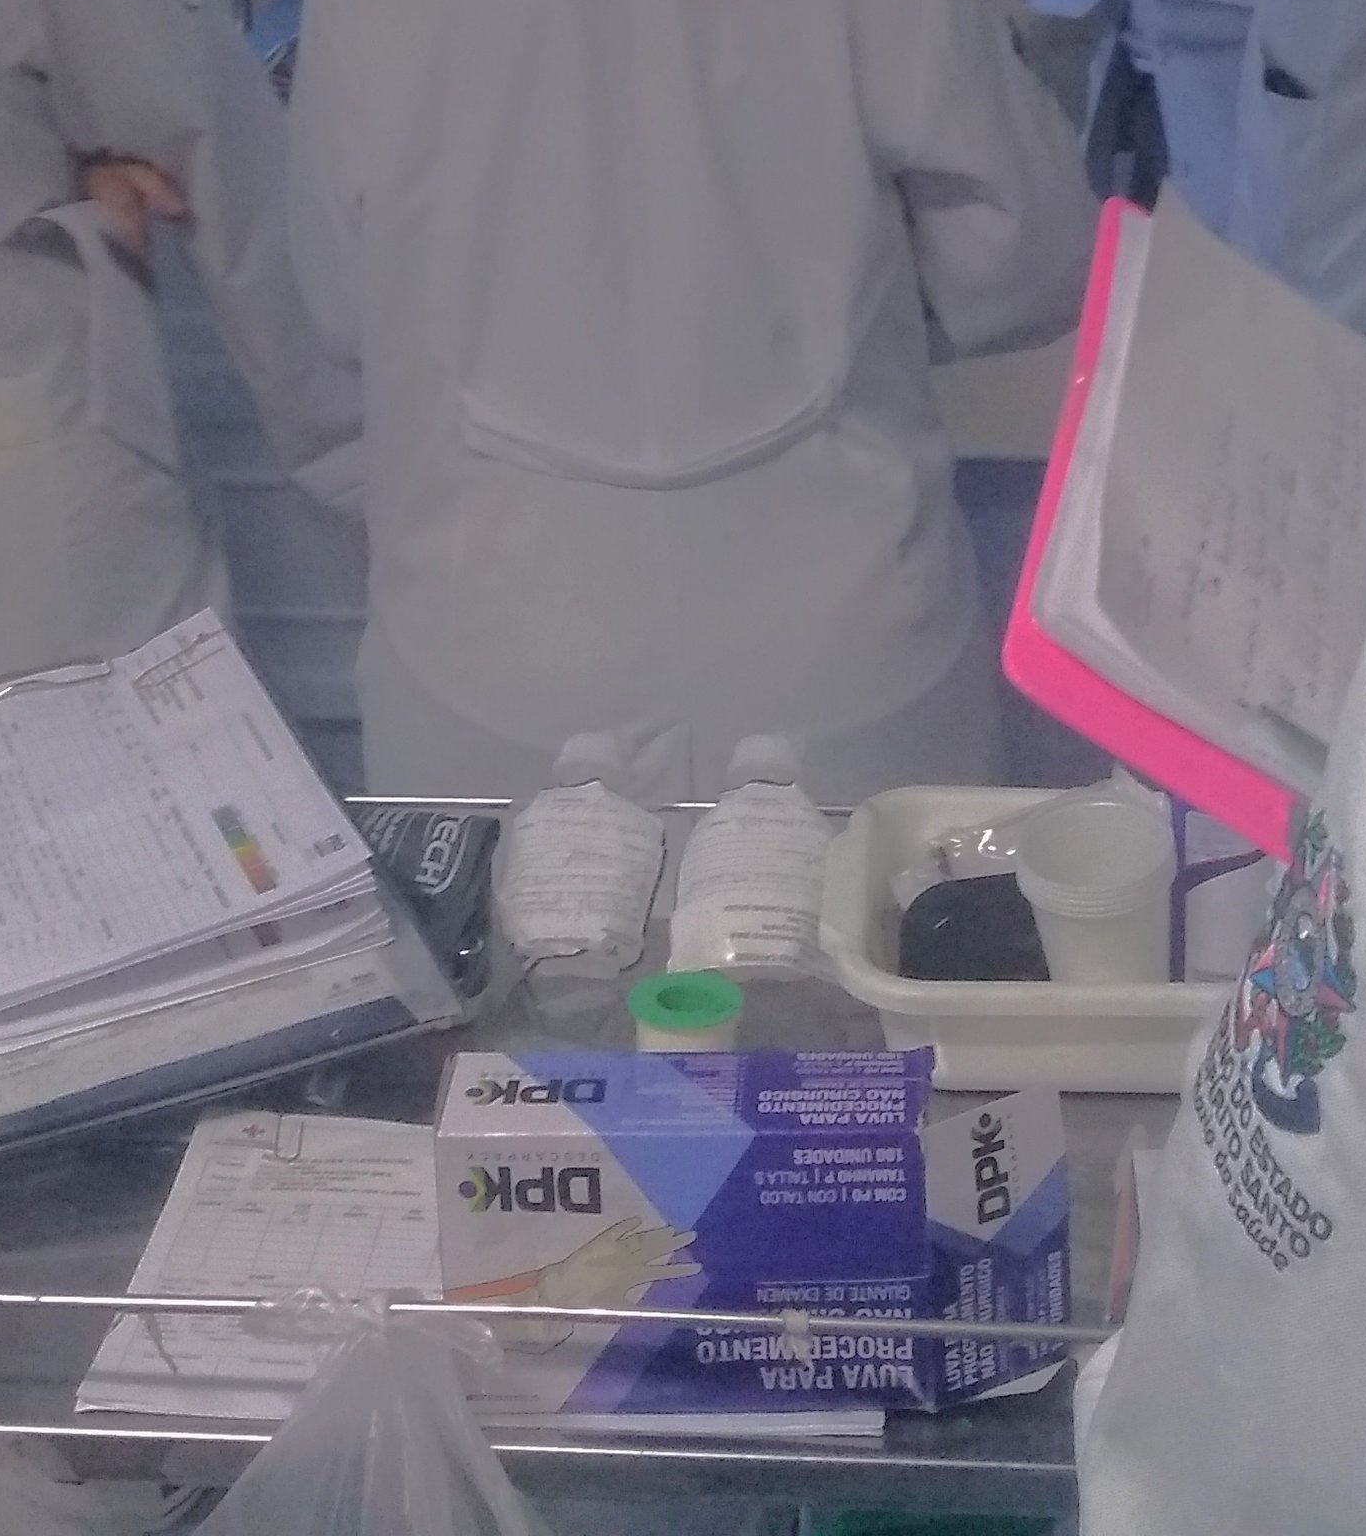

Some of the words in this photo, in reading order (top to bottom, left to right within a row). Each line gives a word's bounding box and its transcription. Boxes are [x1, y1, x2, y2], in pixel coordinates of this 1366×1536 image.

[471, 1079, 606, 1105] DPK
[757, 1100, 905, 1113] PROCEDIMENTO
[798, 1112, 851, 1125] PARA
[855, 1111, 905, 1125] LUVA
[793, 1147, 872, 1164] UNIDADES
[876, 1146, 904, 1163] 100
[971, 1118, 1011, 1224] DPK
[468, 1166, 601, 1214] DPK
[1249, 1124, 1333, 1242] ESTADO
[760, 1190, 804, 1205] TALCO
[874, 1187, 907, 1202] COM
[1240, 1157, 1311, 1259] SANTO
[756, 1287, 819, 1303] EXAMEN
[824, 1286, 844, 1302] DE
[849, 1284, 911, 1302] GUANTE
[759, 1365, 834, 1390] PARA
[842, 1364, 914, 1390] LUVA
[944, 1348, 962, 1392] LUVA
